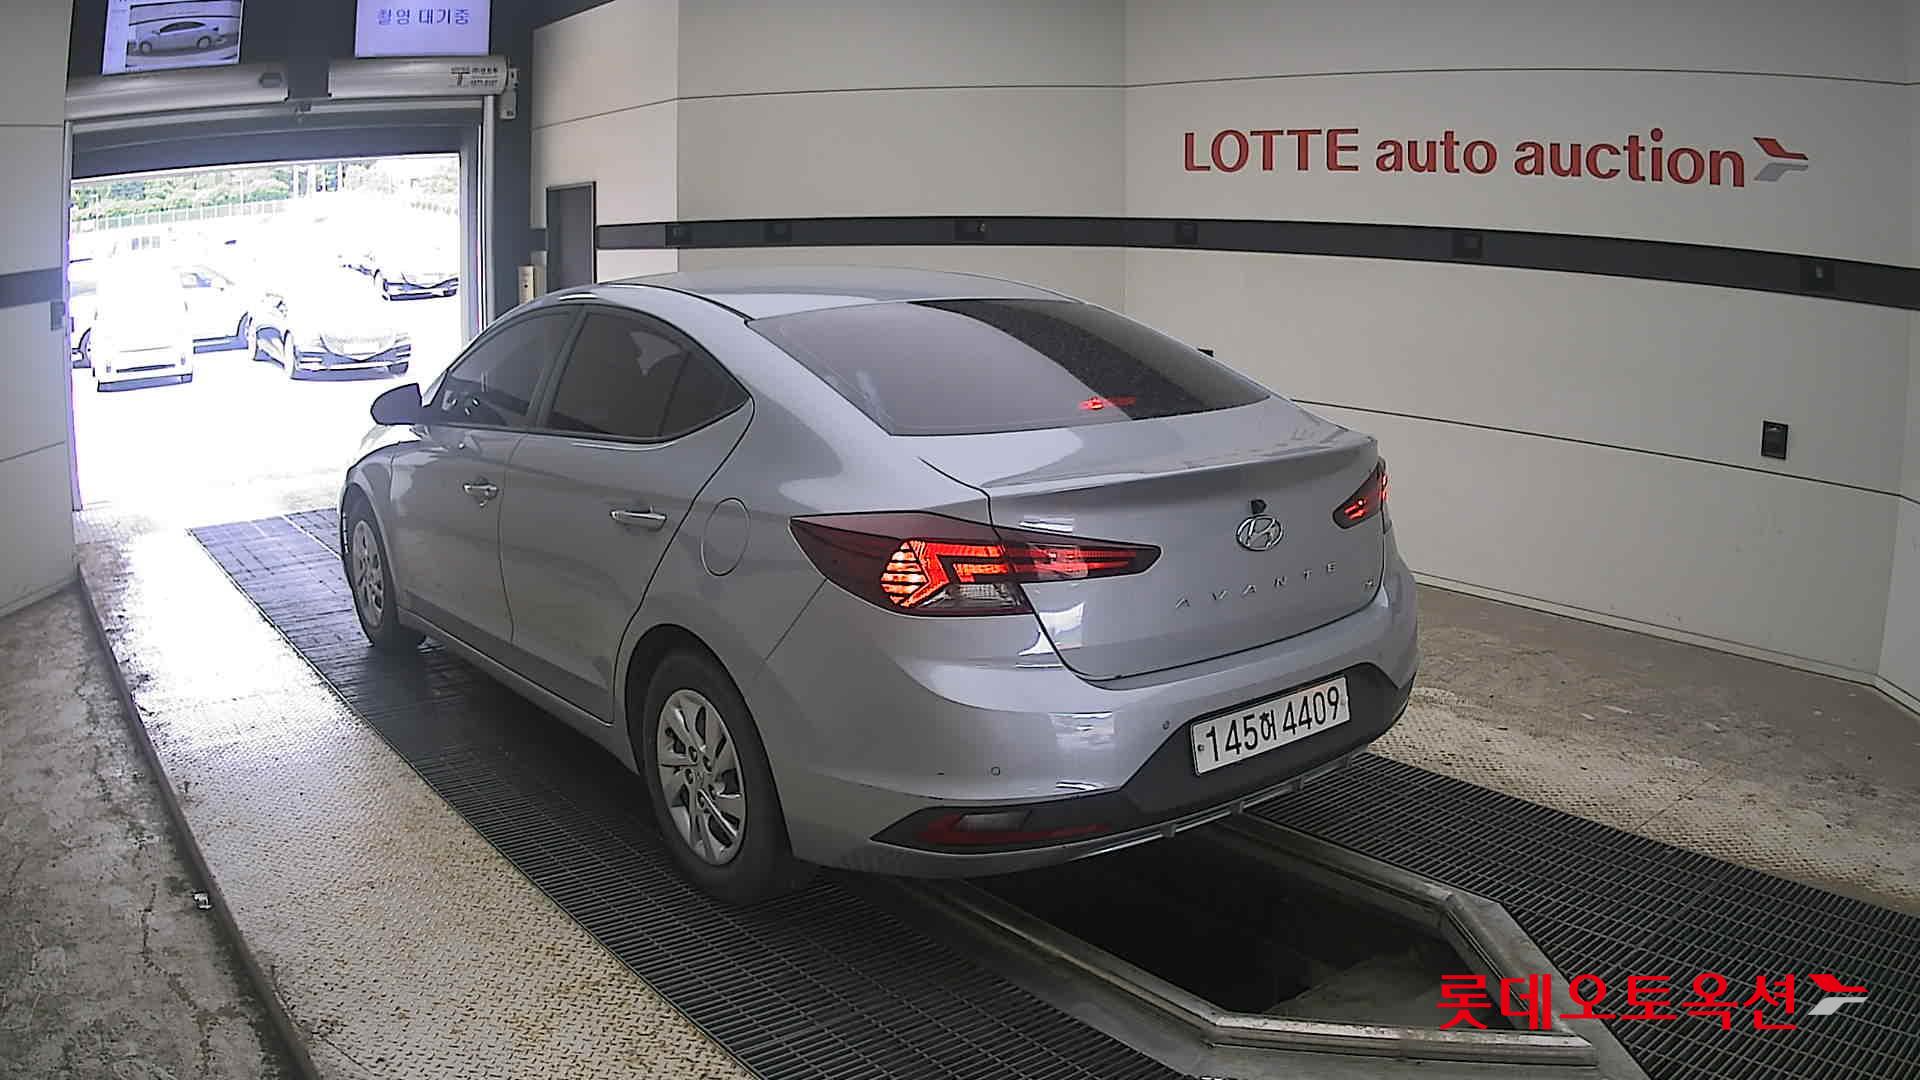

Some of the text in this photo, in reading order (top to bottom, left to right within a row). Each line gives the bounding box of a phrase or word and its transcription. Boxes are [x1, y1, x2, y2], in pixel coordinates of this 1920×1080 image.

[419, 9, 470, 25] 대기중
[1184, 128, 1745, 188] LOTTE auto auction
[1175, 562, 1337, 609] AVANTE
